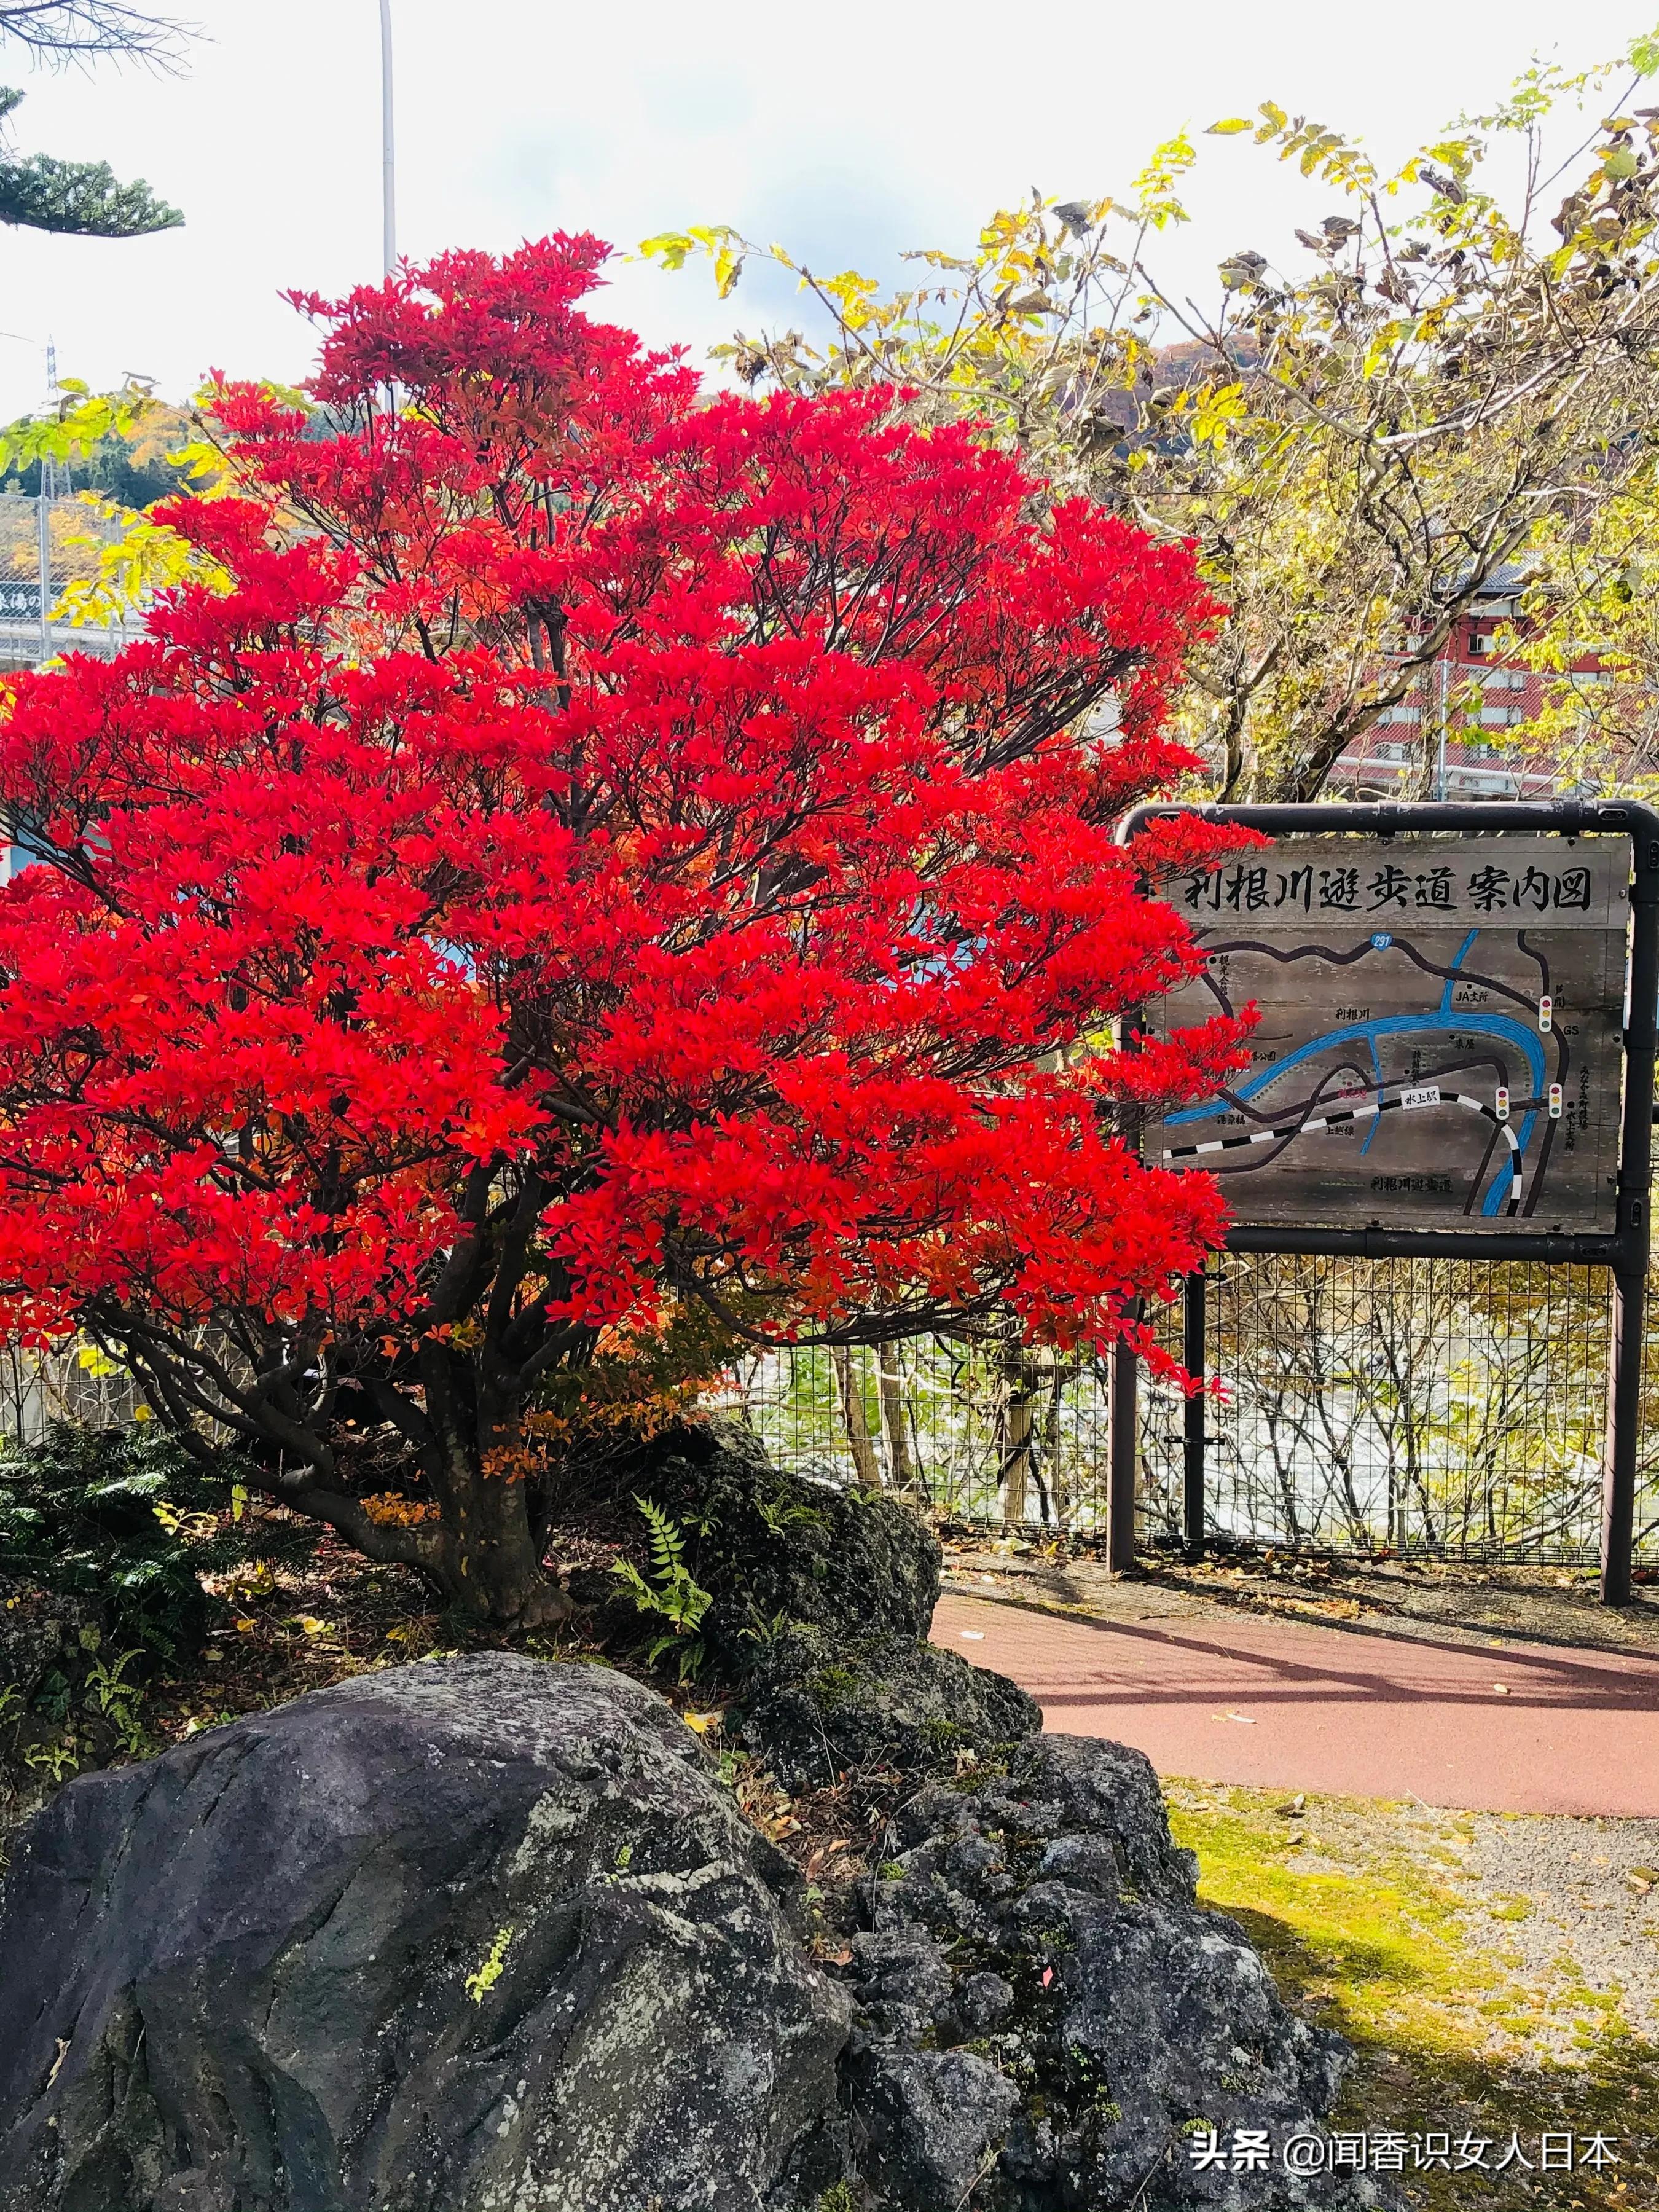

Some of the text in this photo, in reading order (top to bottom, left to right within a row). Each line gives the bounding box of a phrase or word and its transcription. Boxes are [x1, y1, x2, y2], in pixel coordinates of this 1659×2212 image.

[1374, 936, 1390, 946] 291
[1456, 991, 1488, 1002] JA支所
[1335, 1008, 1370, 1020] 利根川
[1564, 1026, 1579, 1035] GS
[1405, 1090, 1438, 1105] 水上駅
[1325, 1126, 1355, 1136] 上越線
[1565, 1111, 1577, 1152] 水上支所
[1370, 1176, 1453, 1193] 利根川遊歩道
